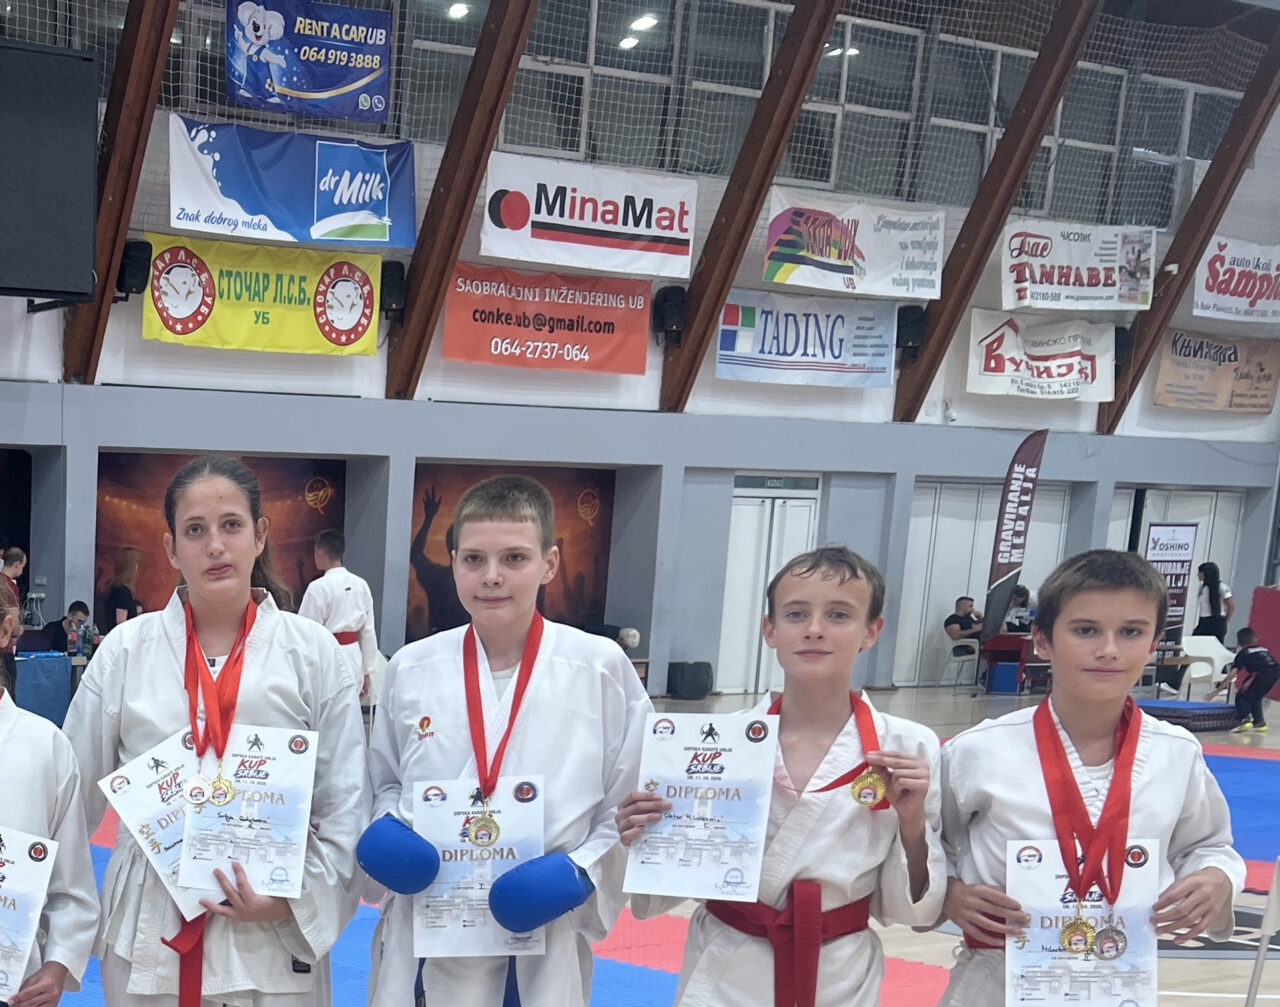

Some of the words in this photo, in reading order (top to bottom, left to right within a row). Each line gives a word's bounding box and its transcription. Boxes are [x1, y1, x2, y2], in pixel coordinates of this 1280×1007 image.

[294, 17, 329, 37] RENT
[331, 22, 340, 37] A
[341, 22, 365, 40] CAR
[367, 27, 386, 45] UB
[300, 46, 326, 62] 064
[327, 50, 347, 65] 919
[348, 53, 380, 69] 3888
[333, 170, 385, 206] Milk
[534, 183, 689, 233] MinaMat
[176, 207, 201, 223] Znak
[204, 210, 239, 230] dobrog
[241, 218, 268, 232] mleka
[1229, 257, 1251, 267] auto
[218, 268, 270, 303] СТОЧАР
[843, 276, 856, 289] UB
[628, 295, 644, 309] UB
[254, 310, 270, 324] УБ
[472, 307, 615, 335] conke.ub@gmail.com
[758, 308, 845, 360] TADING
[490, 337, 590, 362] 064-2737-064
[998, 463, 1025, 563] GRAVIRANJE
[1010, 467, 1037, 563] MEDALJA
[1151, 537, 1189, 551] YOSHINO
[238, 759, 267, 769] KUP
[688, 764, 724, 774] SRBIJE
[690, 752, 722, 764] KUP
[157, 772, 180, 794] KUP
[666, 786, 742, 800] DIPLOMA
[233, 789, 286, 805] PLOMA
[157, 808, 186, 830] DIPL
[442, 847, 517, 862] DIPLOMA
[1040, 916, 1126, 929] DIPOMA
